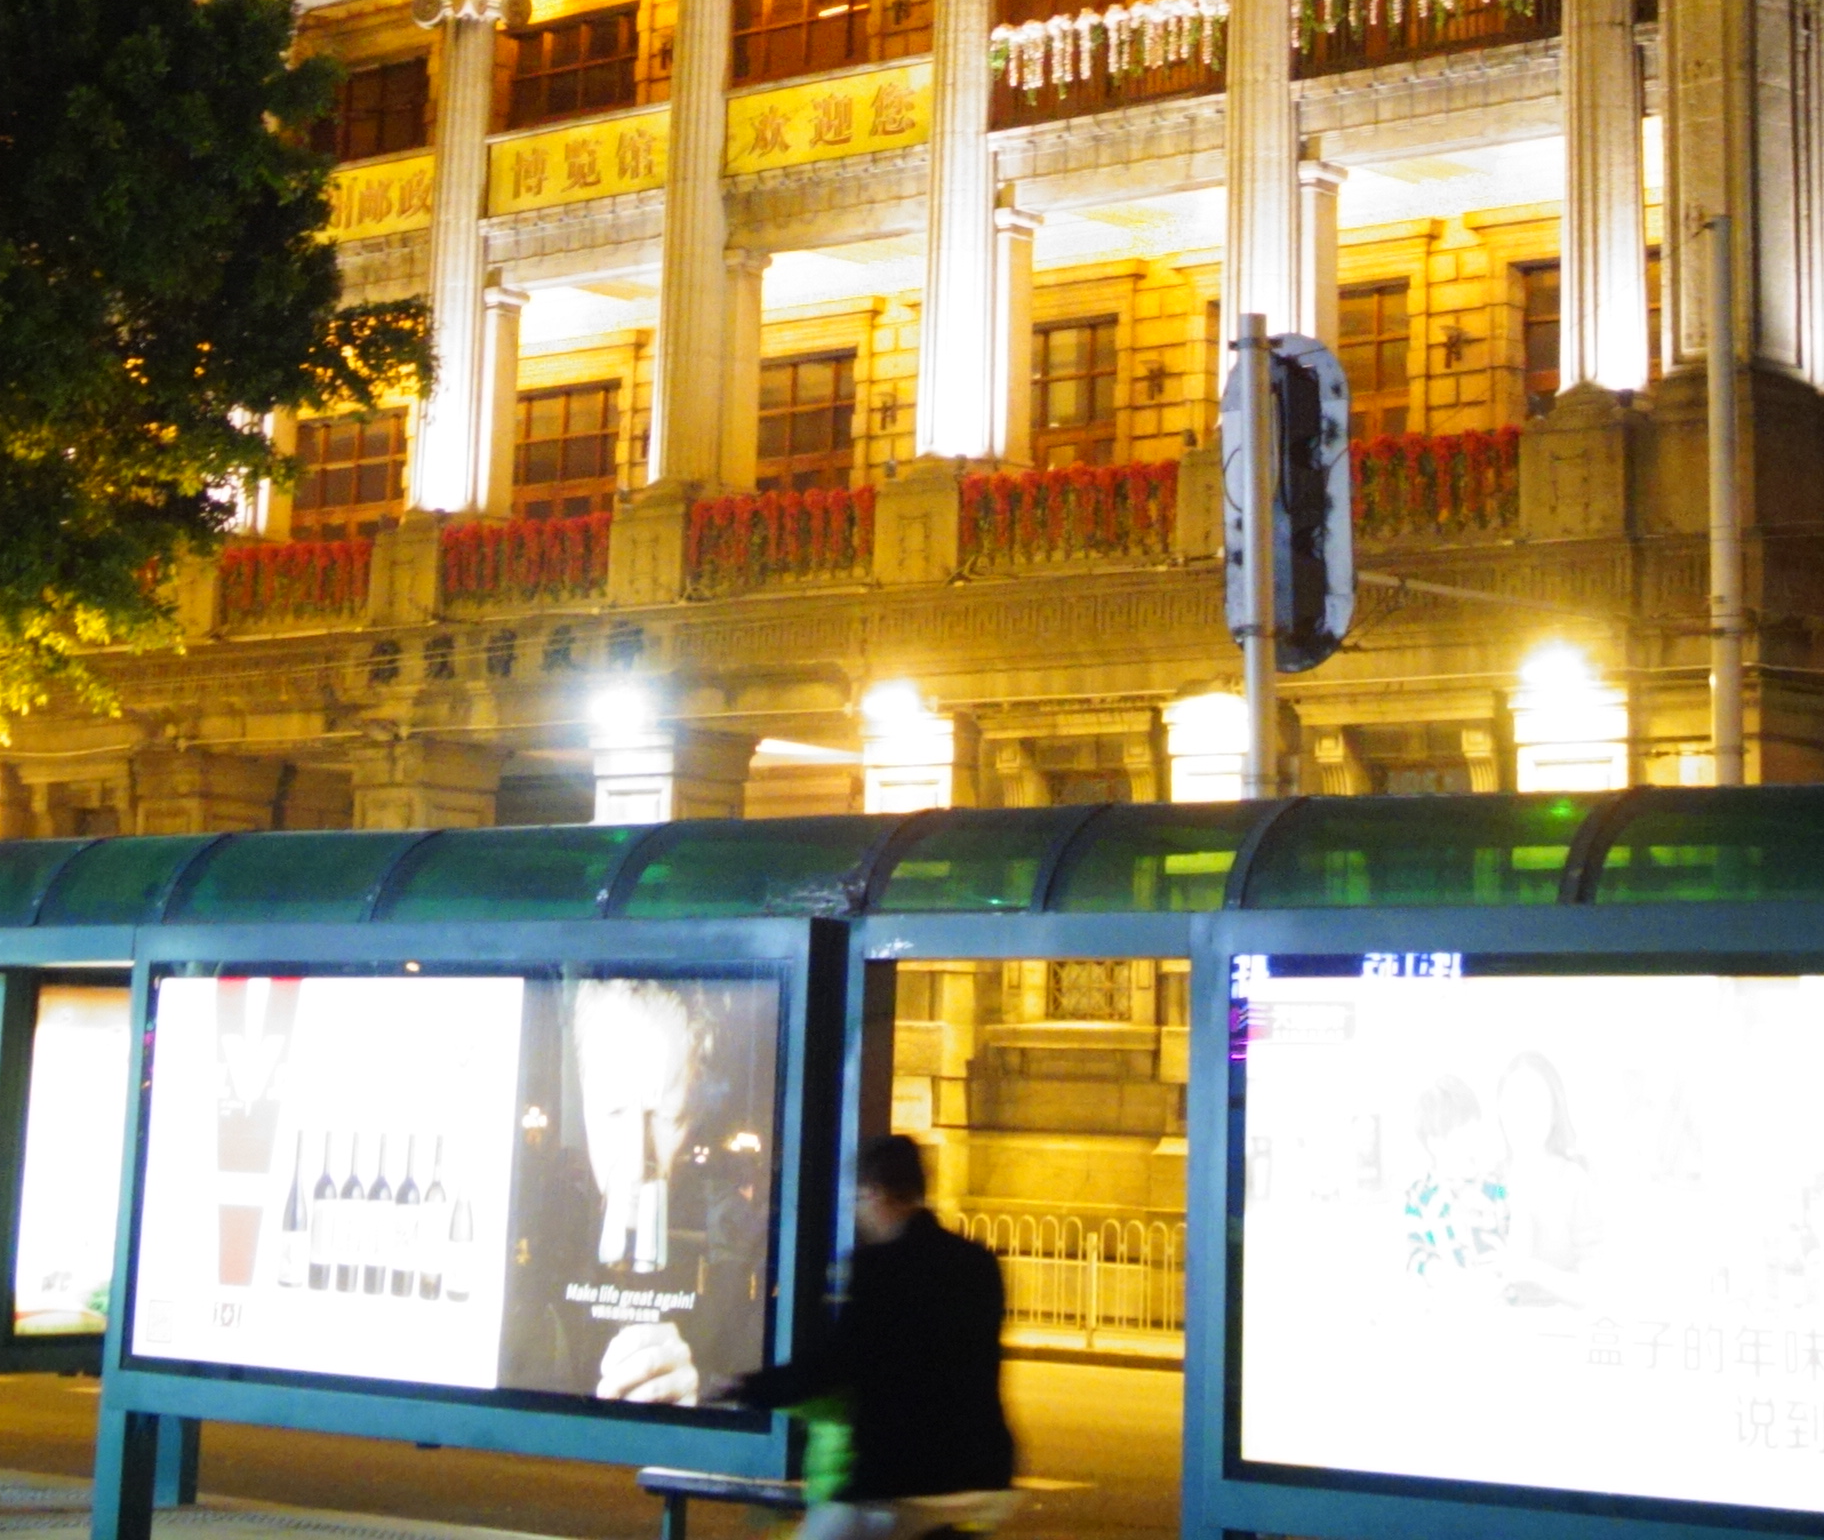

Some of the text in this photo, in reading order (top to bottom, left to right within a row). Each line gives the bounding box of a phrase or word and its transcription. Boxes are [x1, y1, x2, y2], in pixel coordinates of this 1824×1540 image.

[510, 128, 655, 200] 博览馆
[748, 82, 917, 157] 欢迎您
[565, 1283, 696, 1312] Make life great again!
